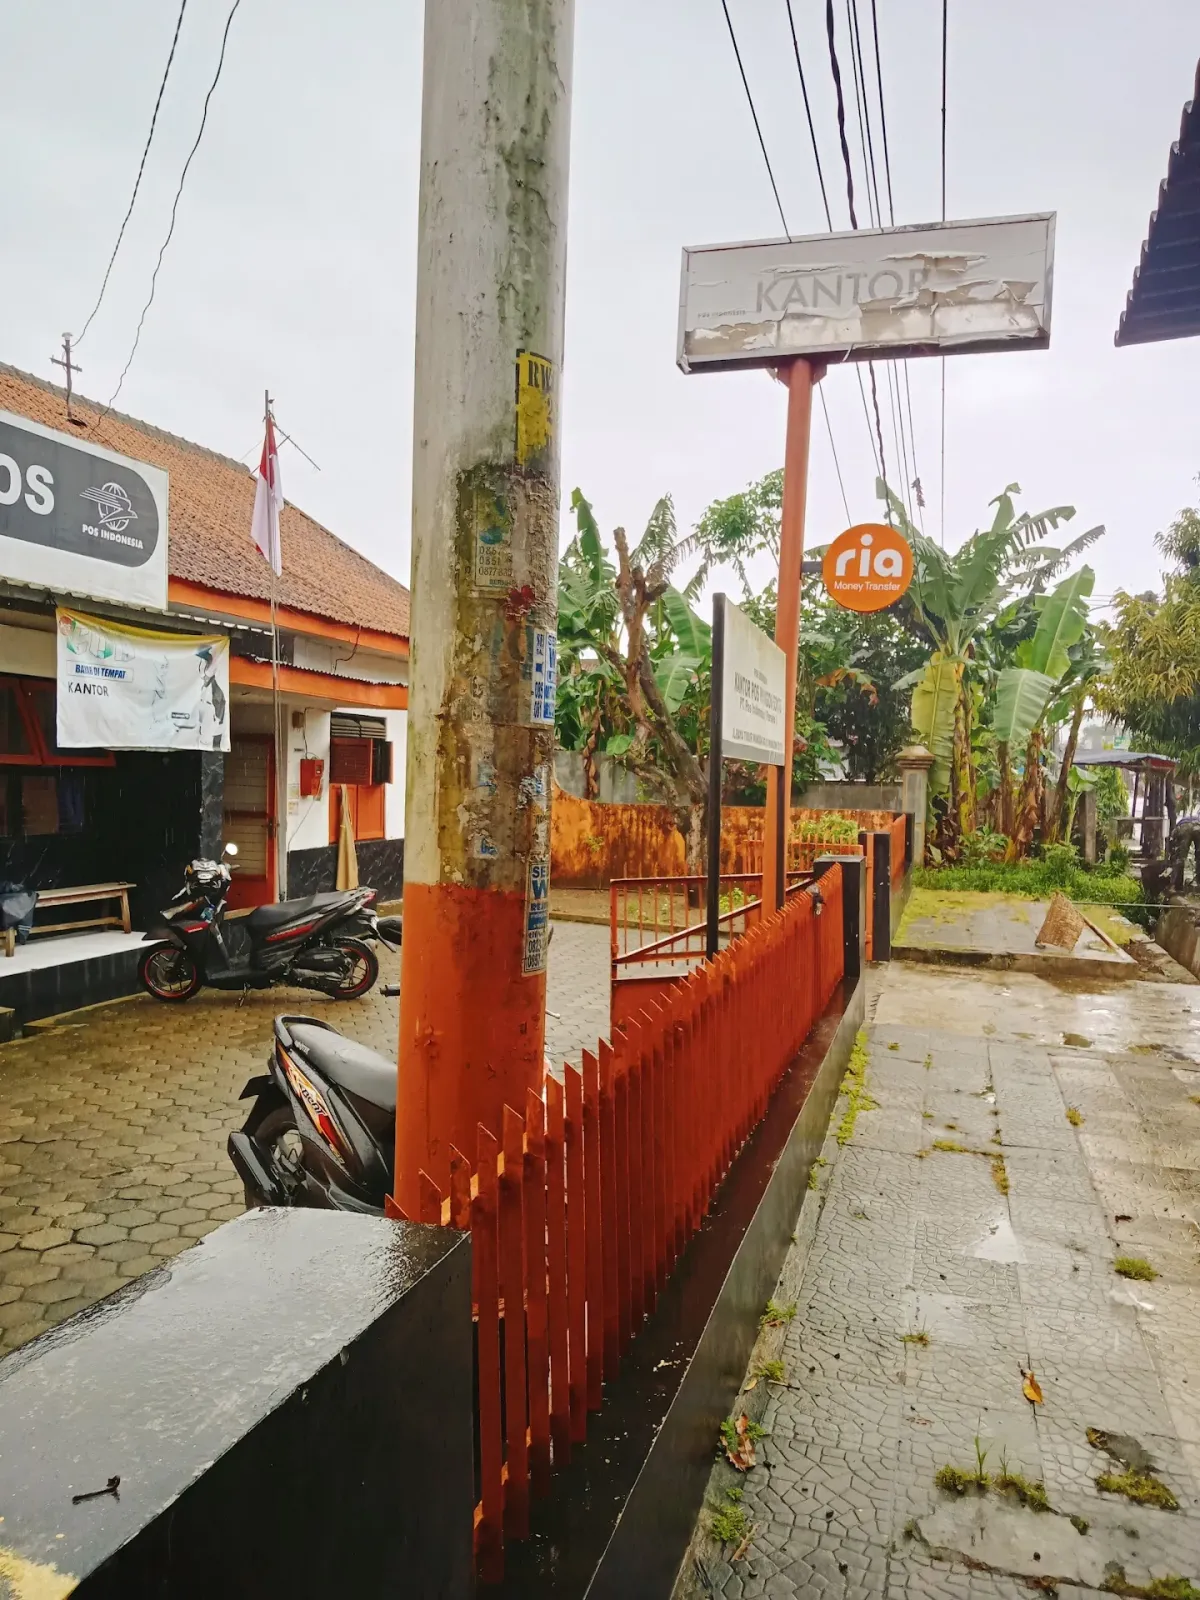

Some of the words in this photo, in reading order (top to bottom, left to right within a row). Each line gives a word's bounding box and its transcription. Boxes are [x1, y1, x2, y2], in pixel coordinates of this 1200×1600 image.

[82, 523, 99, 537] POS
[100, 528, 144, 550] INDONESIA
[835, 533, 903, 578] ria
[834, 580, 863, 592] Money
[864, 580, 901, 592] Transfer
[93, 666, 100, 676] DI
[101, 667, 127, 680] TEMPAT
[67, 681, 109, 697] KANTOR
